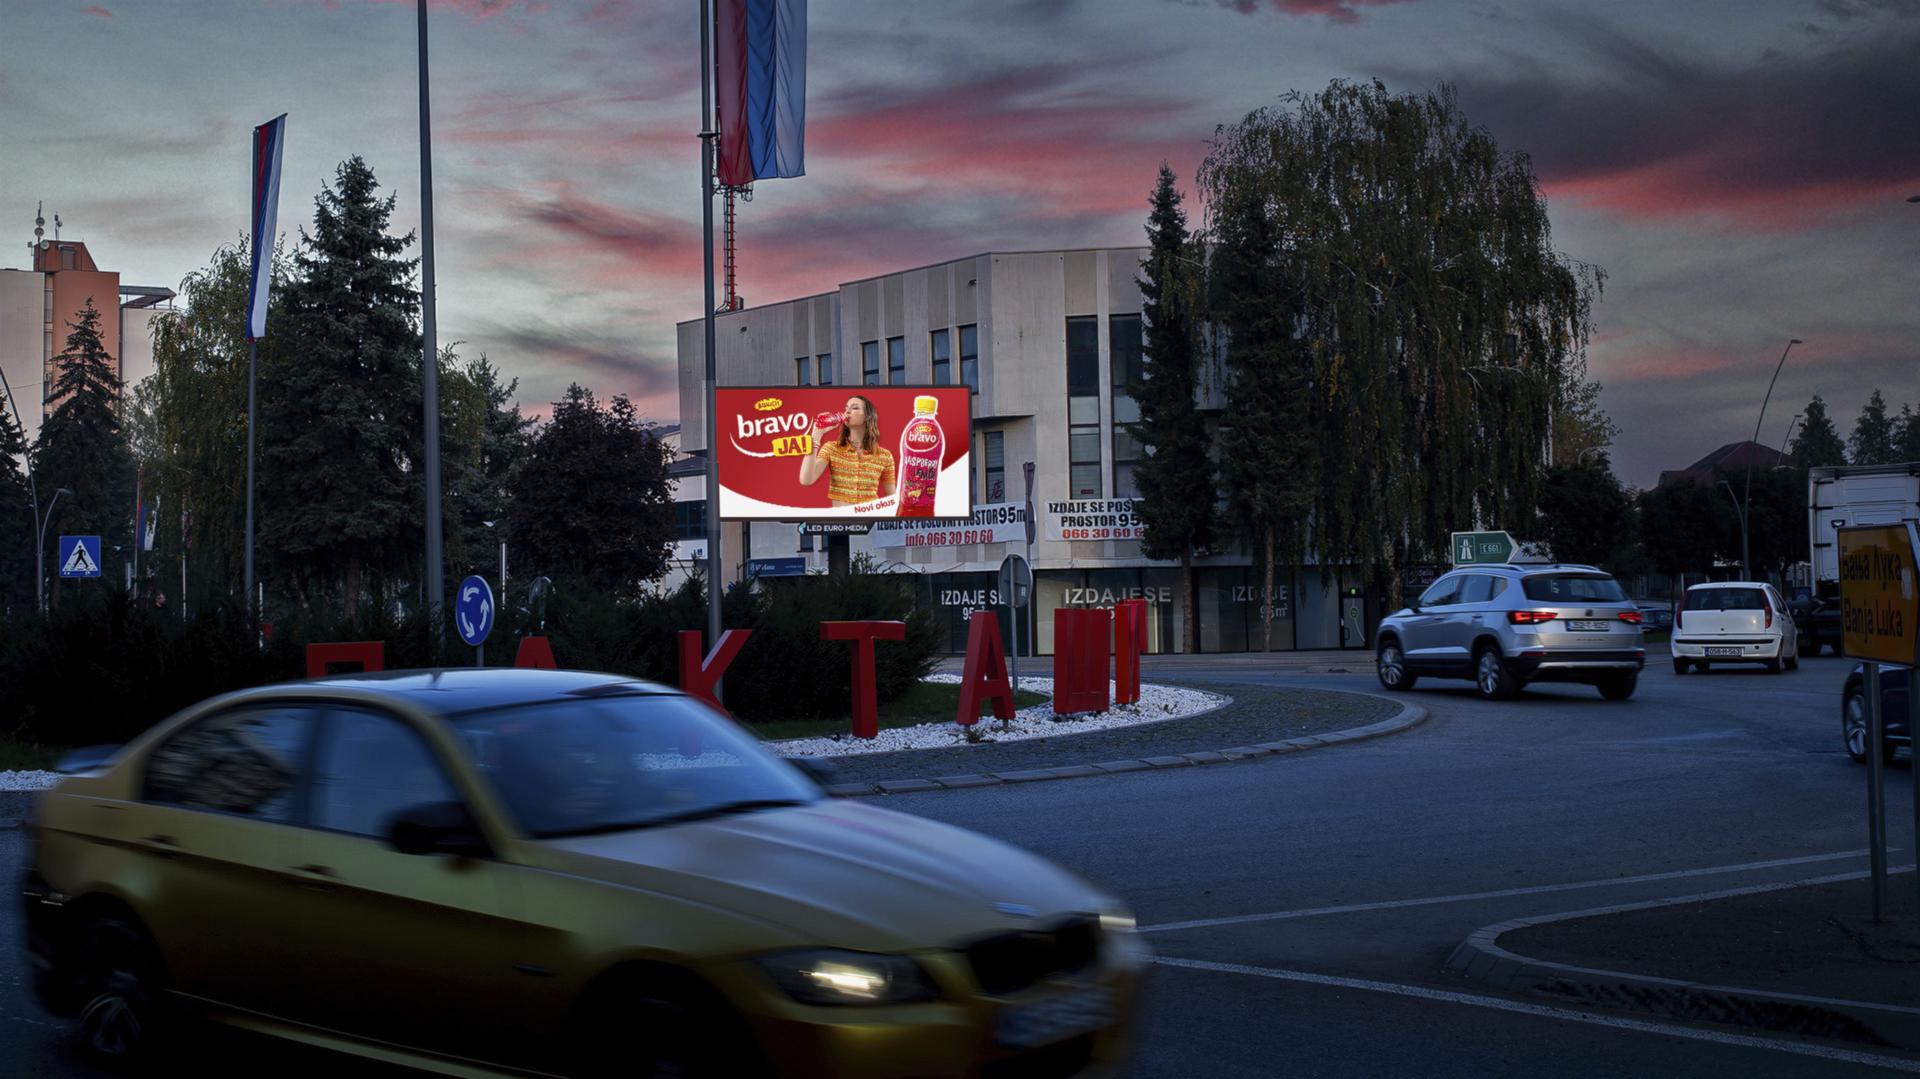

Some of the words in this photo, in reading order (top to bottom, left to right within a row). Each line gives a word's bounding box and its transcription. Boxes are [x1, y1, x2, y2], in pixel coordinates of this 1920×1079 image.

[736, 413, 808, 439] bravo
[908, 431, 937, 443] bravo
[778, 437, 807, 455] JA!
[854, 504, 874, 513] Novi
[875, 499, 895, 510] okus
[1049, 501, 1088, 513] IZDAJE
[1090, 501, 1104, 513] SE
[1061, 515, 1117, 527] PROSTOR
[949, 531, 962, 545] 30
[964, 530, 977, 544] 60
[1062, 528, 1089, 539] 066
[1092, 528, 1110, 538] 30
[1113, 528, 1131, 538] 60
[1134, 528, 1144, 537] 6
[1873, 548, 1902, 590] Лука
[940, 589, 986, 605] IZDAJE
[1232, 584, 1288, 601] IZDJE
[1844, 598, 1874, 644] Banja
[1876, 599, 1903, 637] Luka
